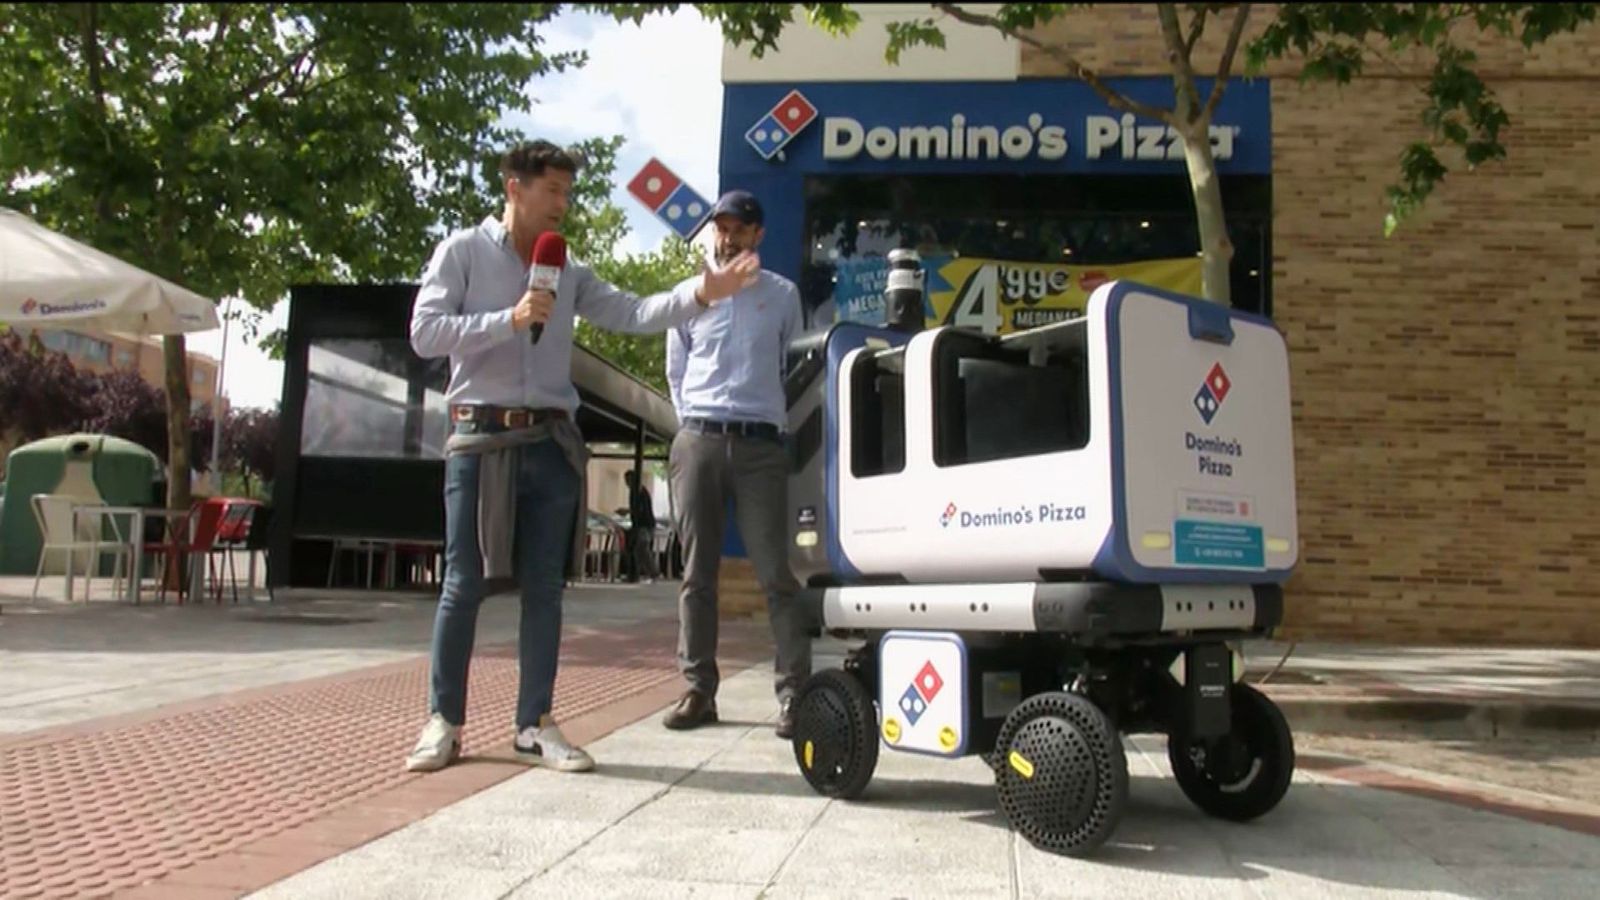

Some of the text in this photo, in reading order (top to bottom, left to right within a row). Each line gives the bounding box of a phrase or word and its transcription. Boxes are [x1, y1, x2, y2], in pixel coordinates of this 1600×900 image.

[822, 113, 1068, 161] Domino's
[40, 299, 107, 315] Domino's
[1185, 431, 1243, 457] Domino's
[1198, 456, 1233, 477] Pizza
[960, 503, 1086, 528] Domino's Pizza
